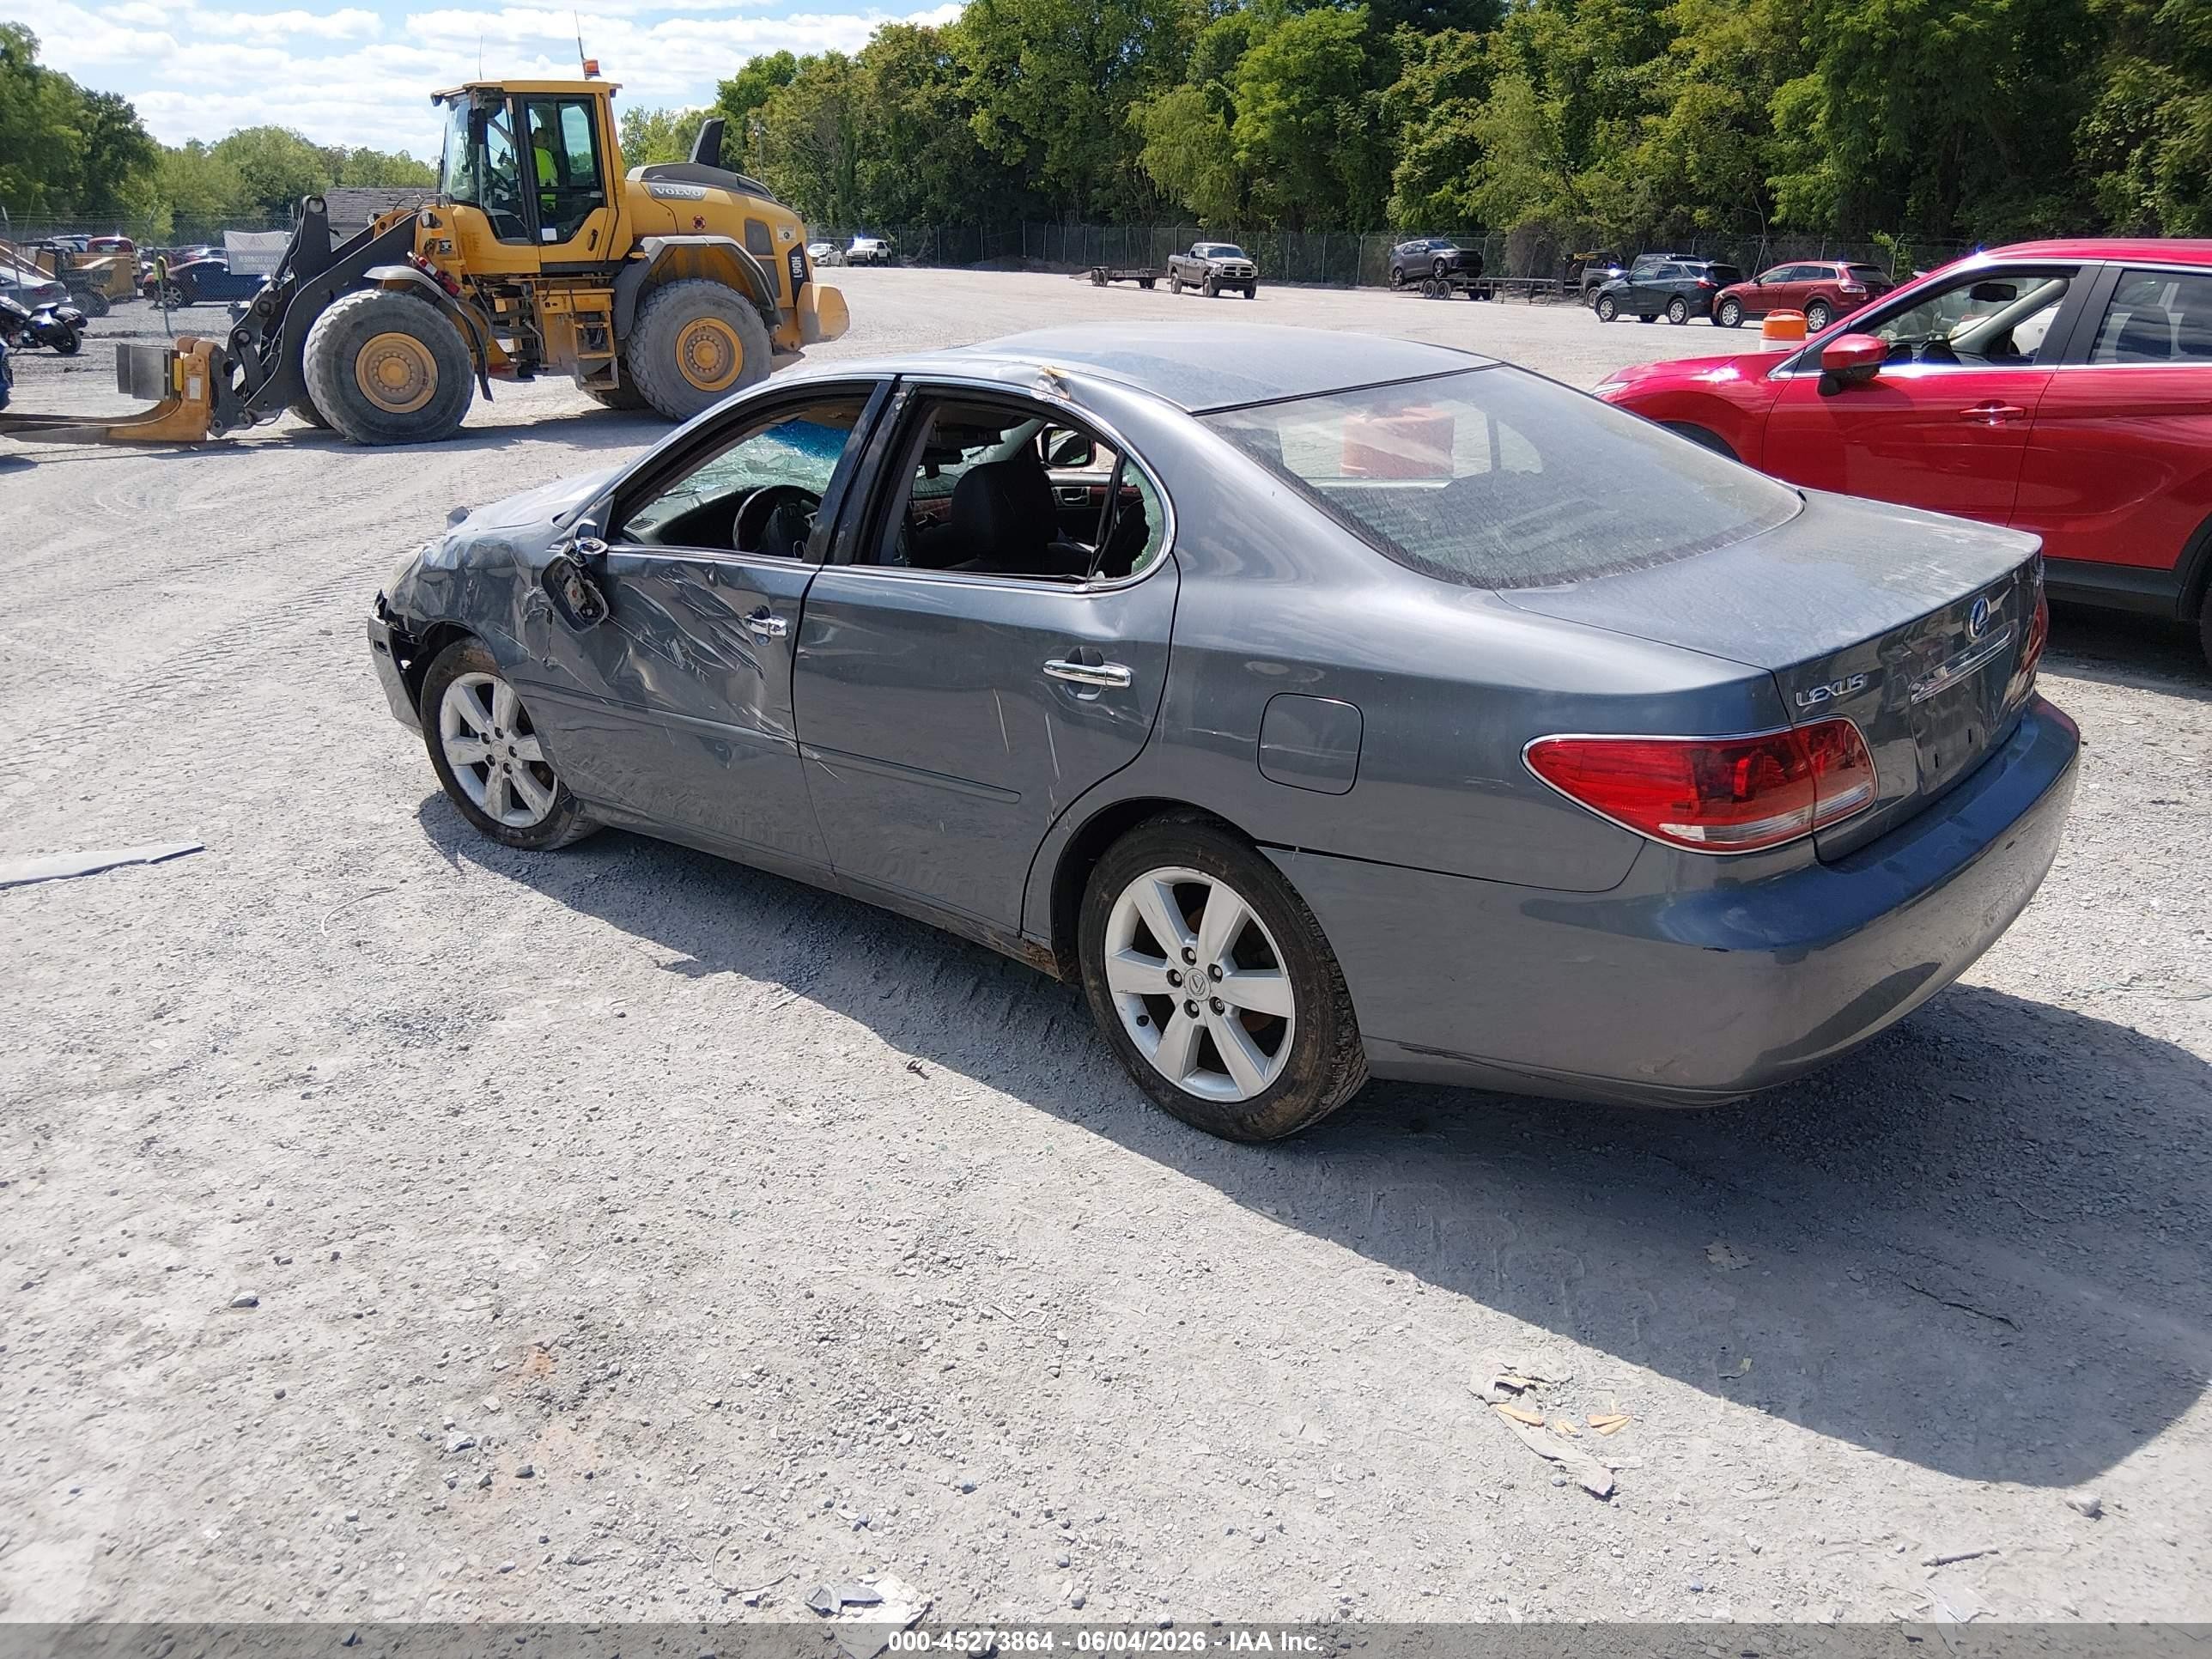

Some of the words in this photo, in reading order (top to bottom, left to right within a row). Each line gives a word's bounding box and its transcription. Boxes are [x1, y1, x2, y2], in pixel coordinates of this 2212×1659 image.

[654, 187, 702, 197] VOLVO
[791, 256, 804, 278] L90H
[1796, 673, 1864, 707] LEXUS
